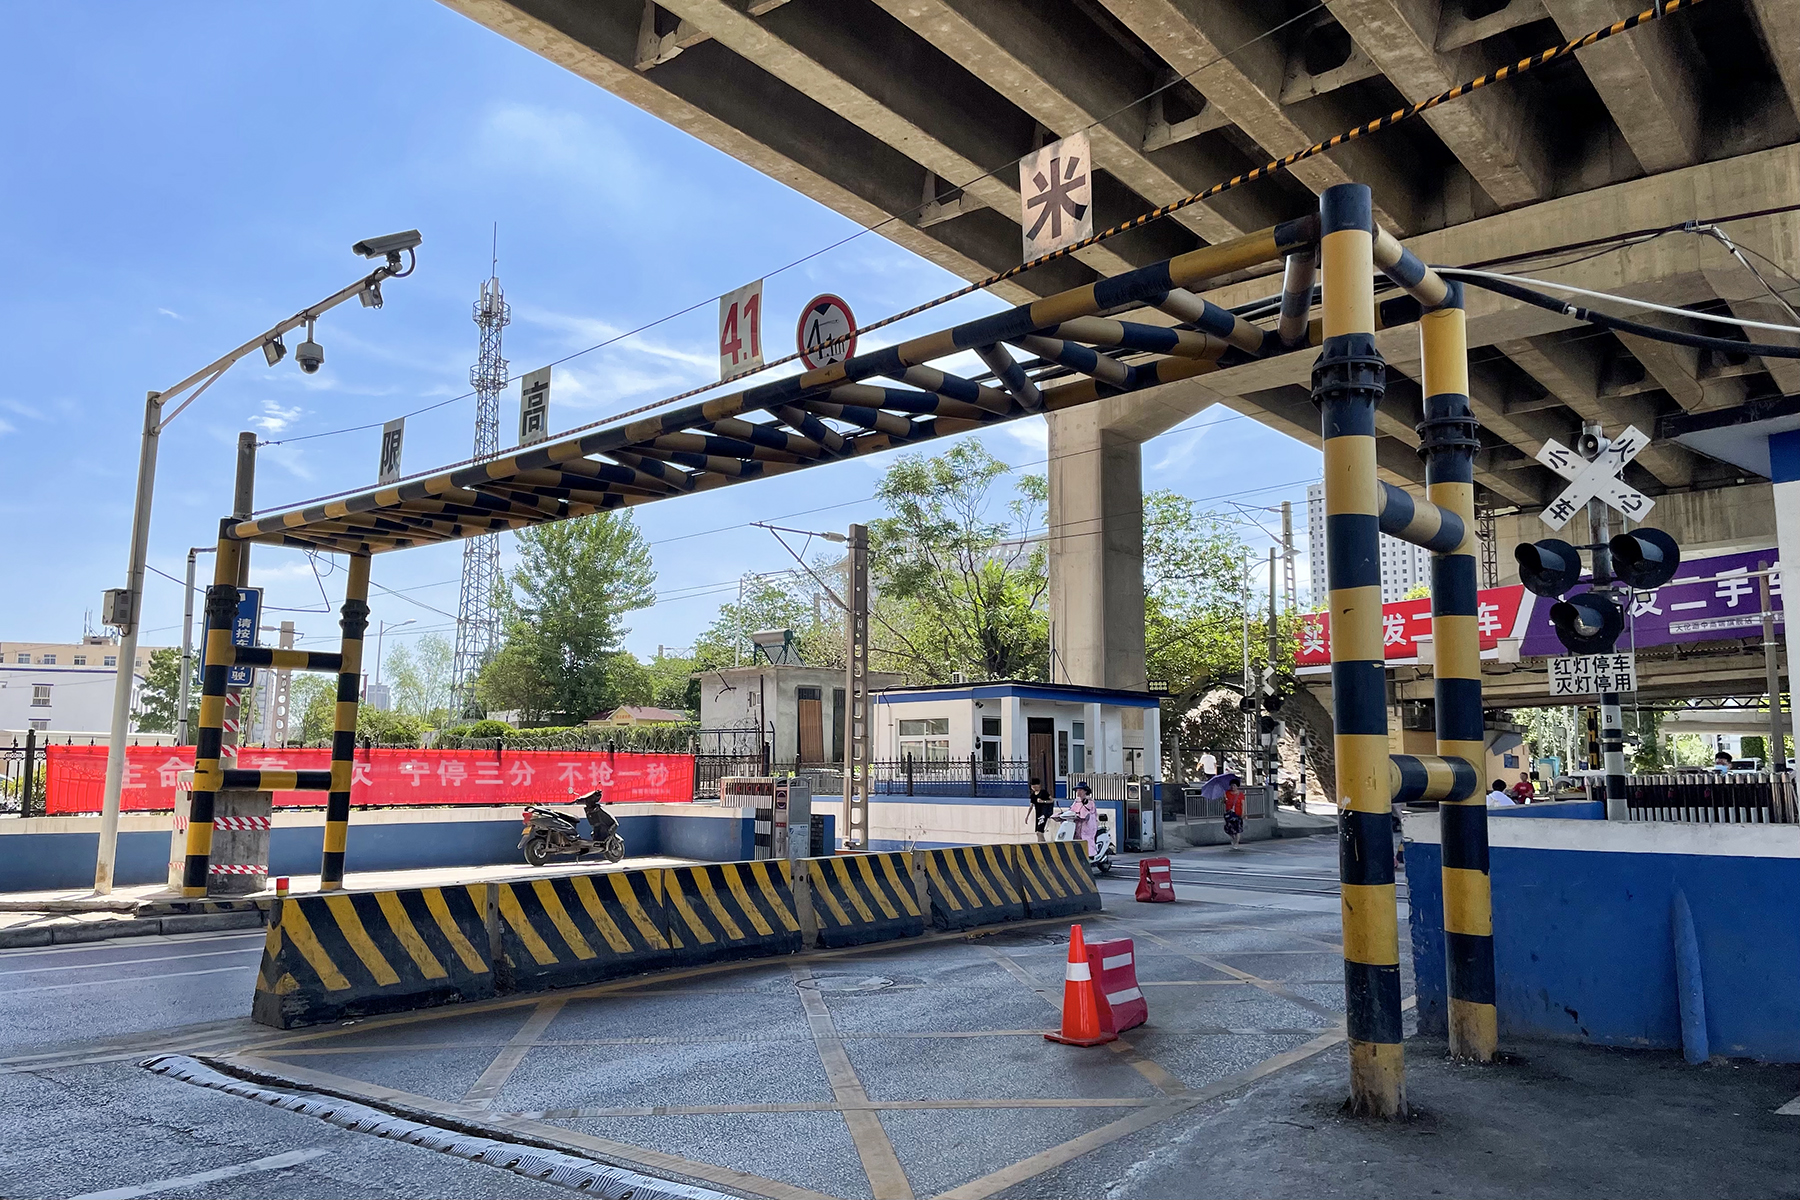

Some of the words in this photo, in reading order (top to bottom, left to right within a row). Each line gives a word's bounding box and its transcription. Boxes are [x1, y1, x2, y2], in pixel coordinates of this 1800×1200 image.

[1026, 157, 1088, 241] 米
[721, 293, 760, 366] 4.1
[522, 381, 549, 437] 高
[380, 429, 402, 476] 限
[1608, 439, 1636, 462] 火
[1548, 450, 1570, 469] 小
[1618, 494, 1643, 513] 心
[1549, 498, 1576, 521] 车
[1554, 655, 1631, 675] 红灯停车
[1555, 674, 1631, 694] 灭灯停用
[1606, 715, 1613, 723] B
[400, 760, 535, 787] 宁停三分
[558, 761, 670, 787] 不抢一秒
